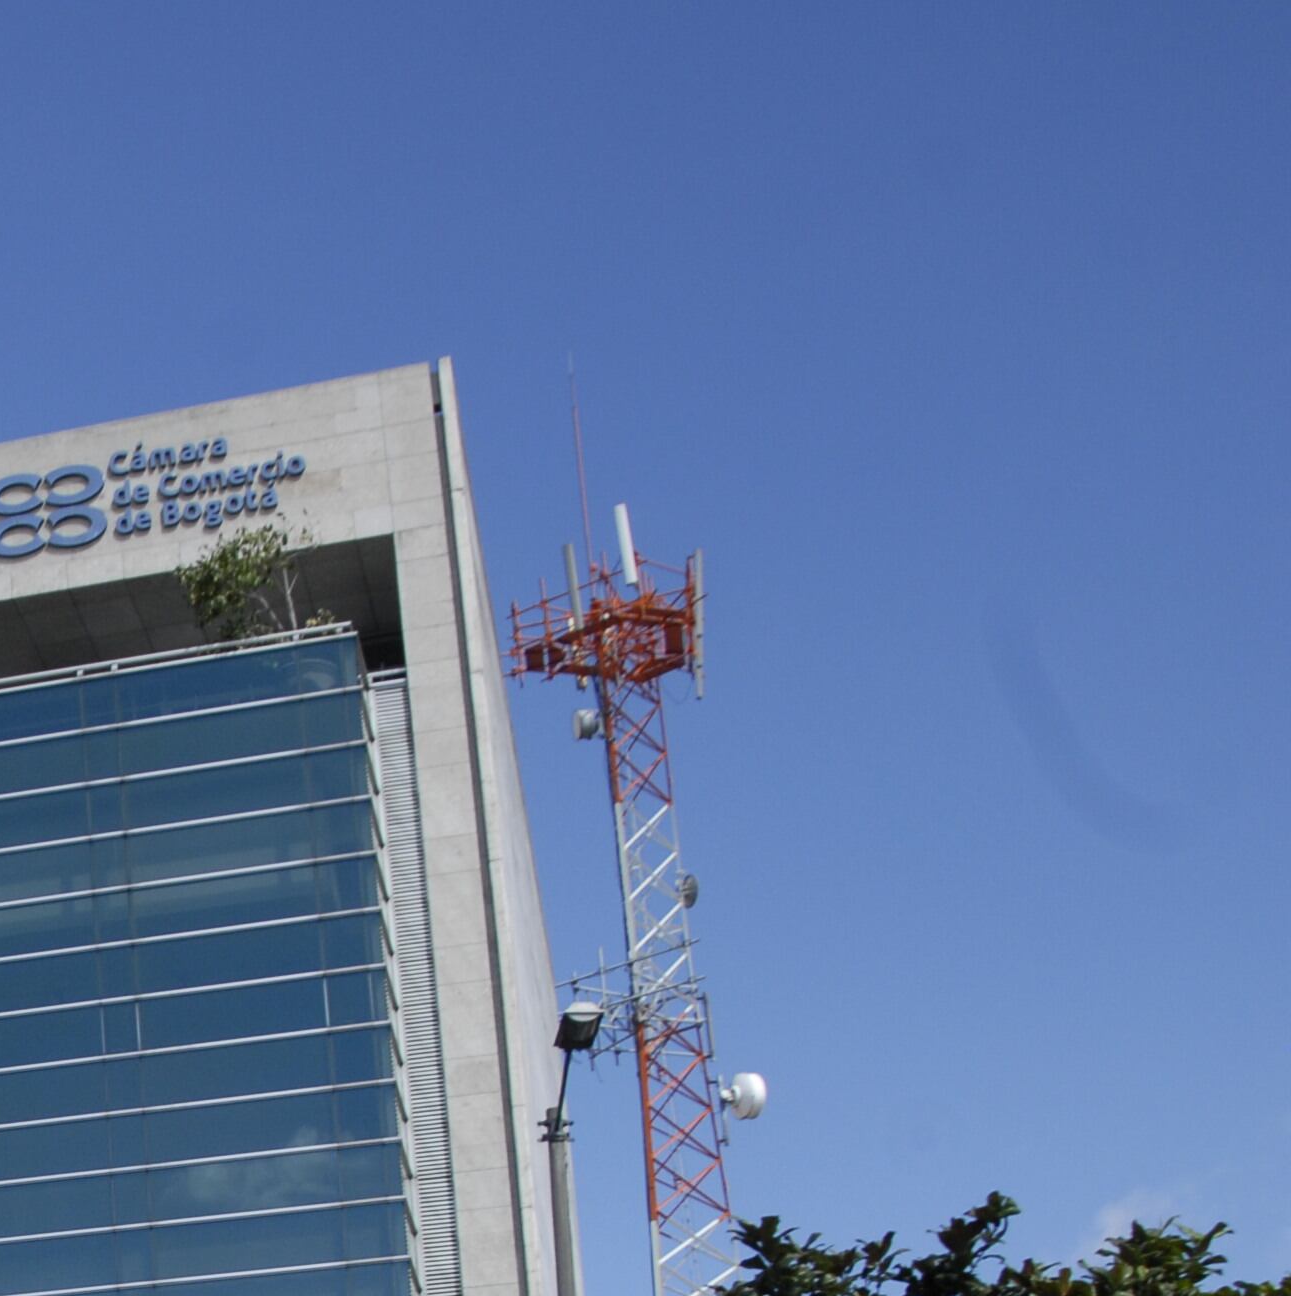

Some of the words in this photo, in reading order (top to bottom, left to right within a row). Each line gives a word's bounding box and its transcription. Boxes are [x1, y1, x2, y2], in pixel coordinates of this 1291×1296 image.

[109, 436, 228, 477] Cámara
[113, 479, 149, 507] de
[157, 451, 306, 500] Comercio
[114, 508, 151, 536] de
[162, 483, 278, 529] Bogotá
